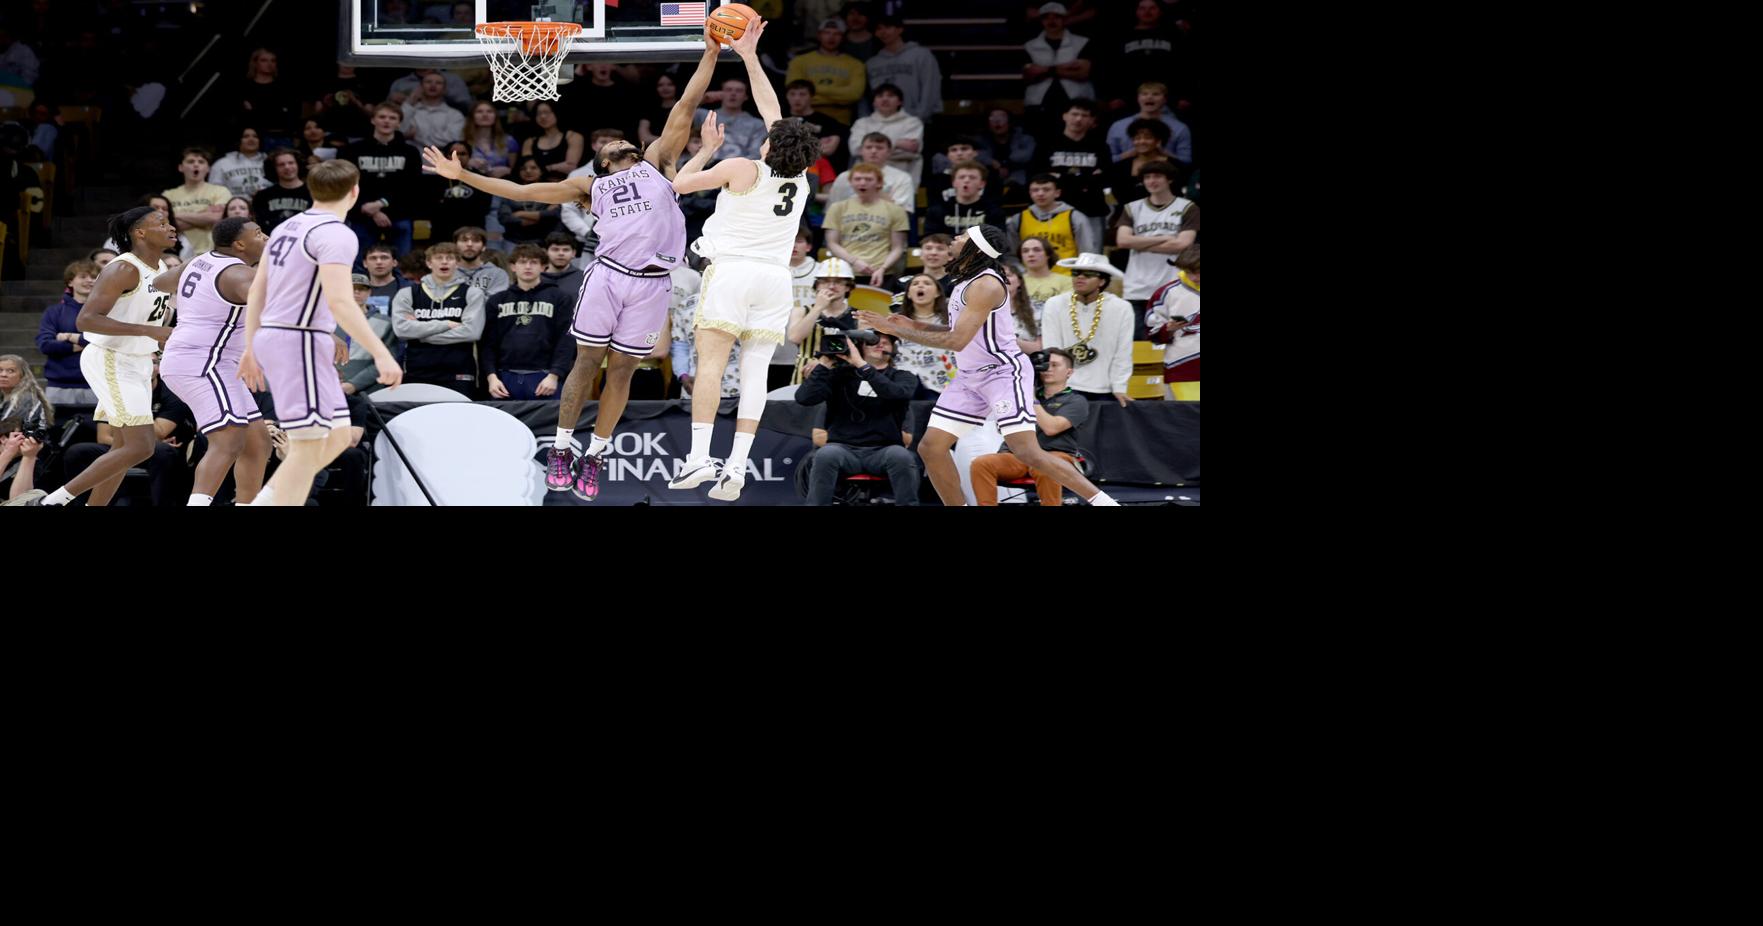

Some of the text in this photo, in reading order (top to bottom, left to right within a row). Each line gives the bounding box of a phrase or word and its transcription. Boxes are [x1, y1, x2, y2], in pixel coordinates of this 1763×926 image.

[612, 182, 642, 204] 21
[773, 182, 798, 217] 3
[609, 200, 652, 218] STATE
[269, 235, 298, 267] 47
[181, 271, 202, 299] 6
[147, 295, 170, 322] 25
[414, 307, 462, 319] COLORADO
[497, 301, 553, 318] COLORADO
